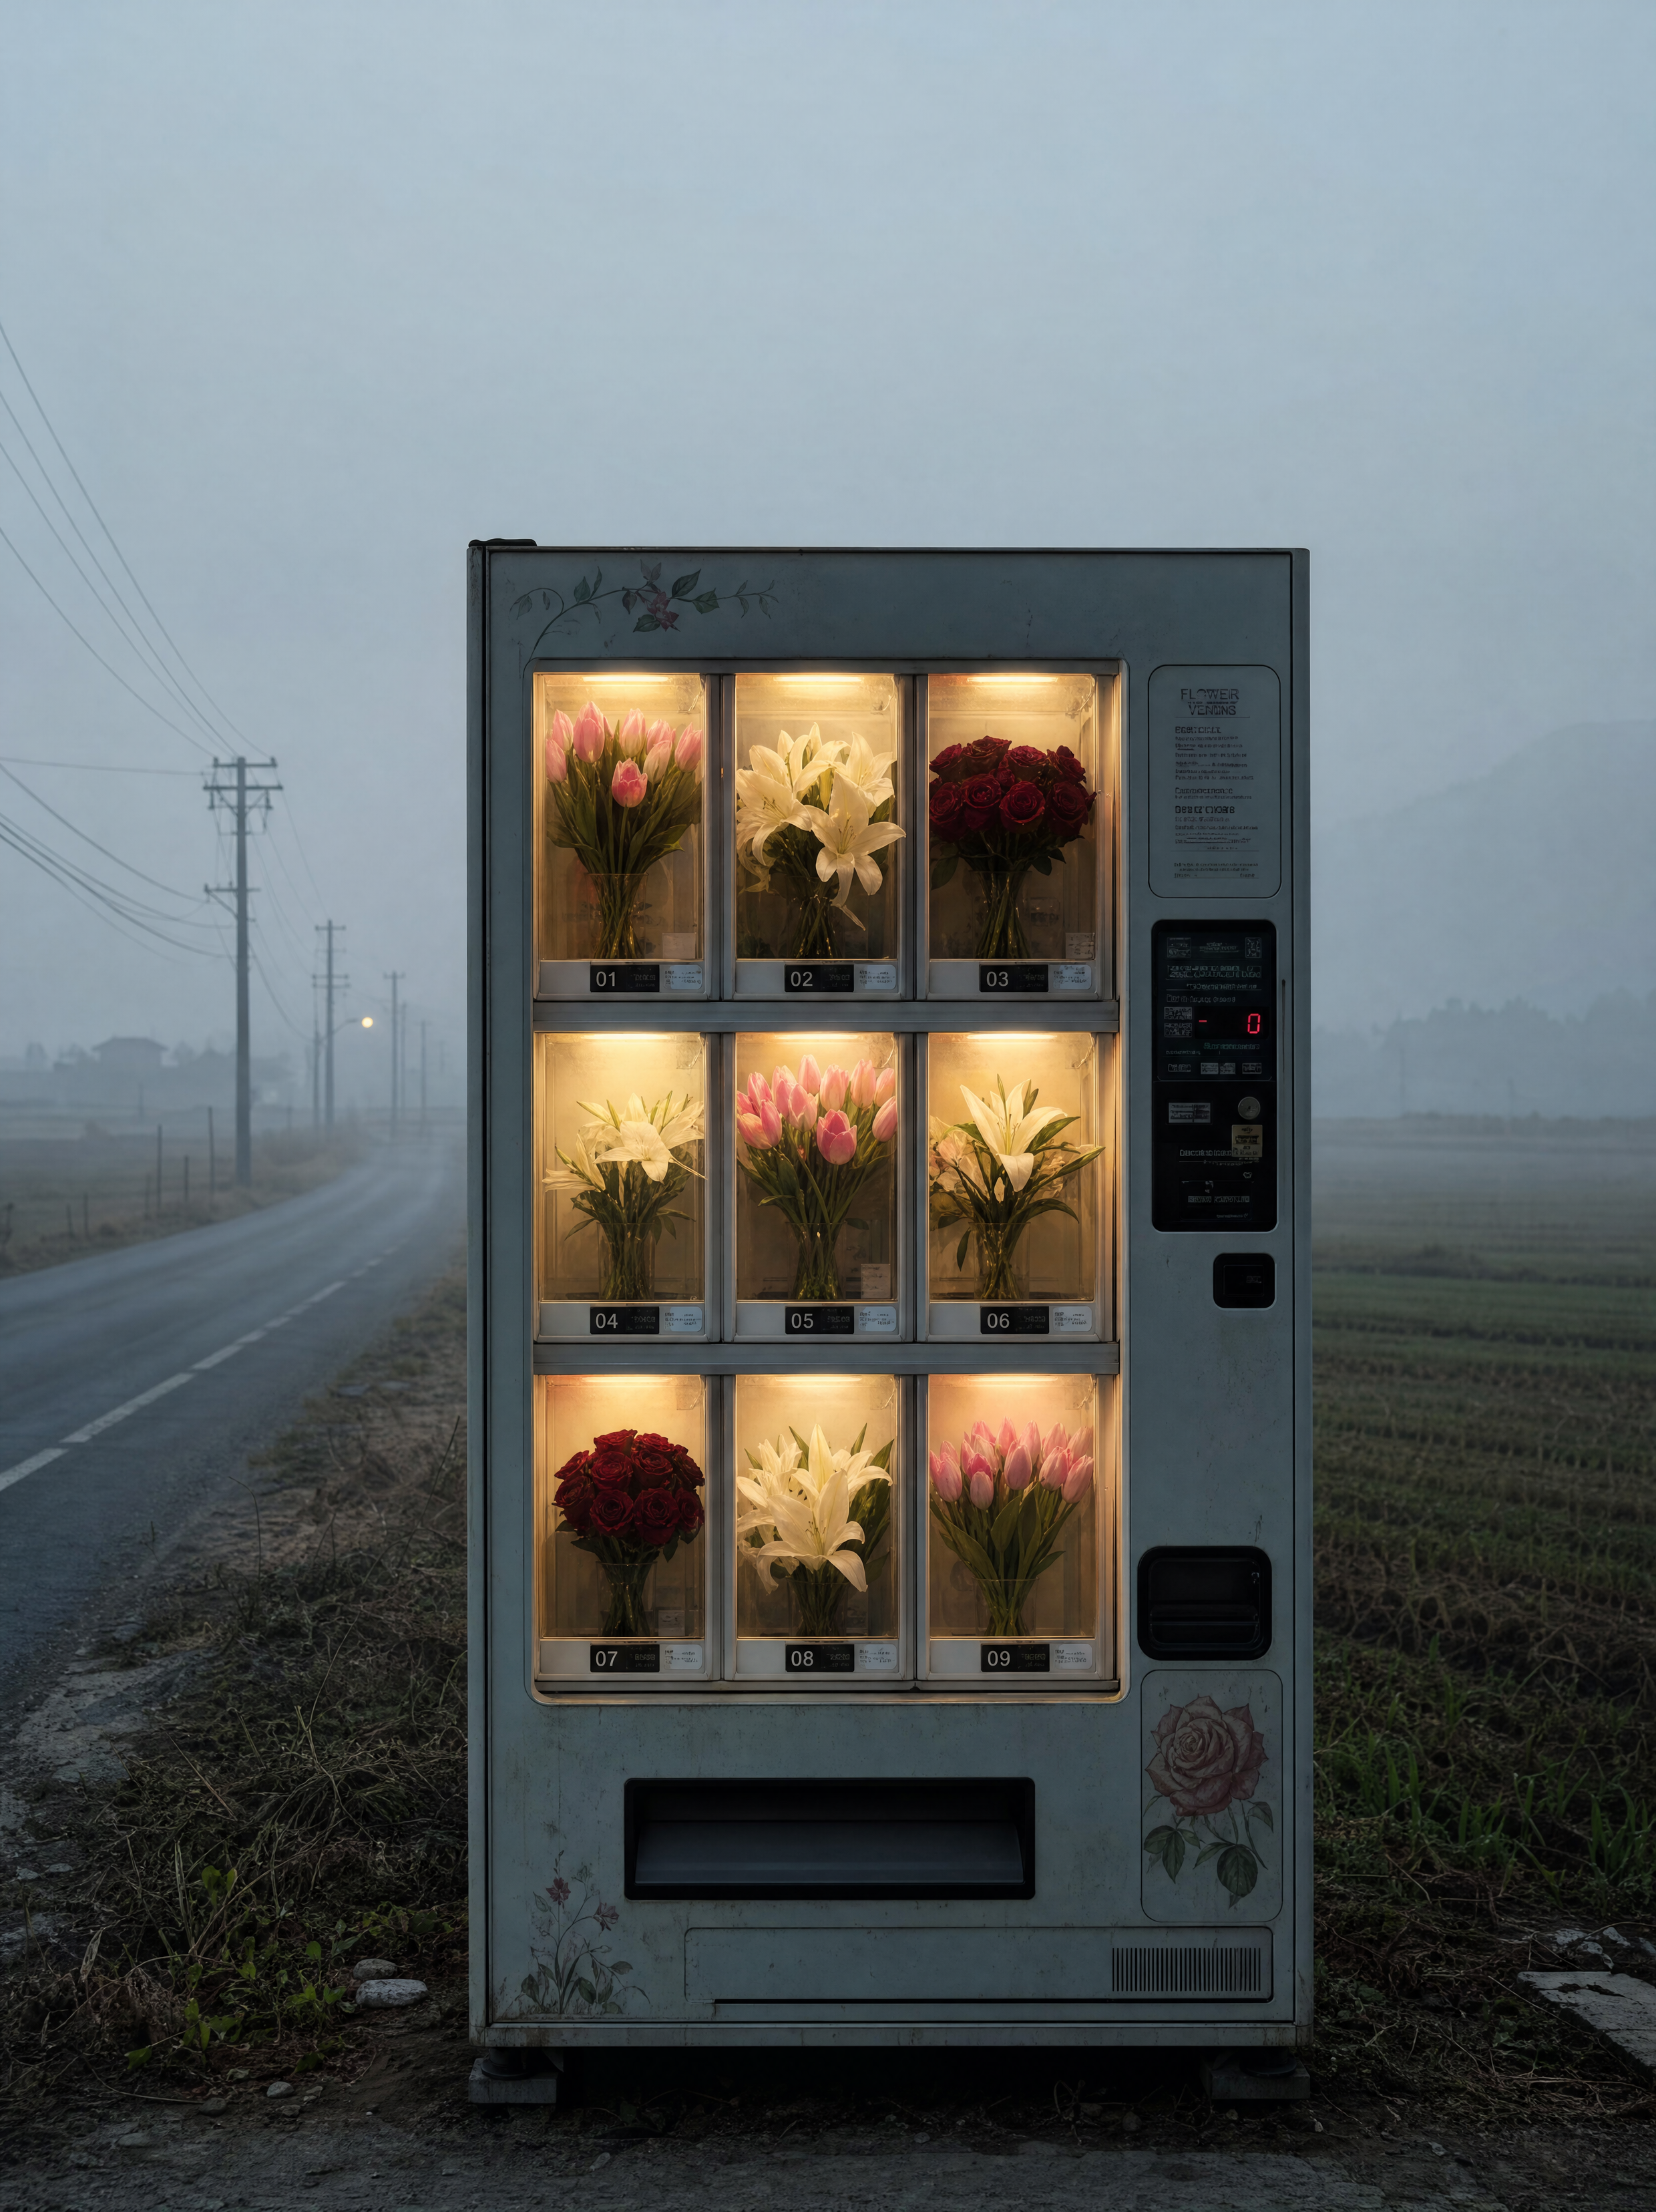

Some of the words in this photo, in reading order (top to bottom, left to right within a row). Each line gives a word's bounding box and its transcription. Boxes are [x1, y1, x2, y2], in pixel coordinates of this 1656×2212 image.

[596, 972, 614, 986] 01
[791, 972, 813, 986] 02
[987, 972, 1008, 986] 03
[1247, 1013, 1261, 1034] 0
[596, 1314, 618, 1328] 04
[792, 1314, 813, 1328] 05
[988, 1314, 1009, 1328] 06
[596, 1651, 618, 1666] 07
[791, 1651, 813, 1666] 08
[988, 1651, 1010, 1666] 09
